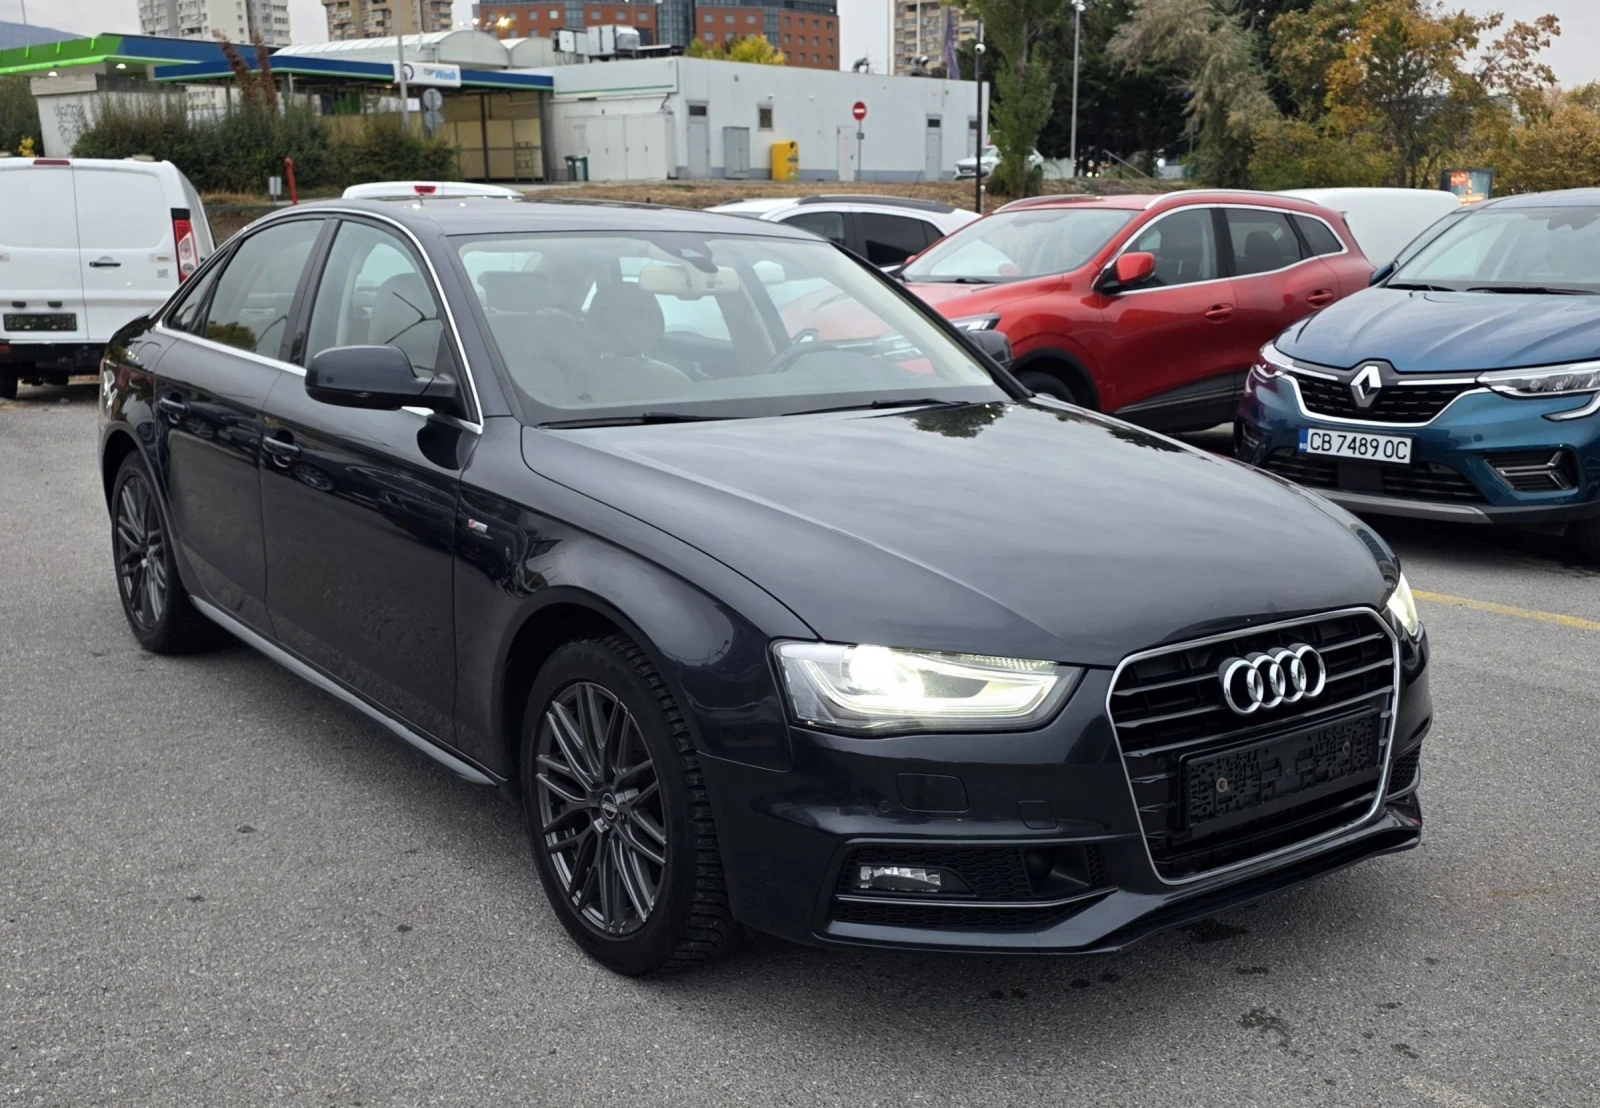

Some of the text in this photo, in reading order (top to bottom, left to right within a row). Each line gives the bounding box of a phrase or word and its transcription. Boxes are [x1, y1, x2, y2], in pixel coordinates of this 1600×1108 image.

[1310, 432, 1408, 460] CB 7489 OC
